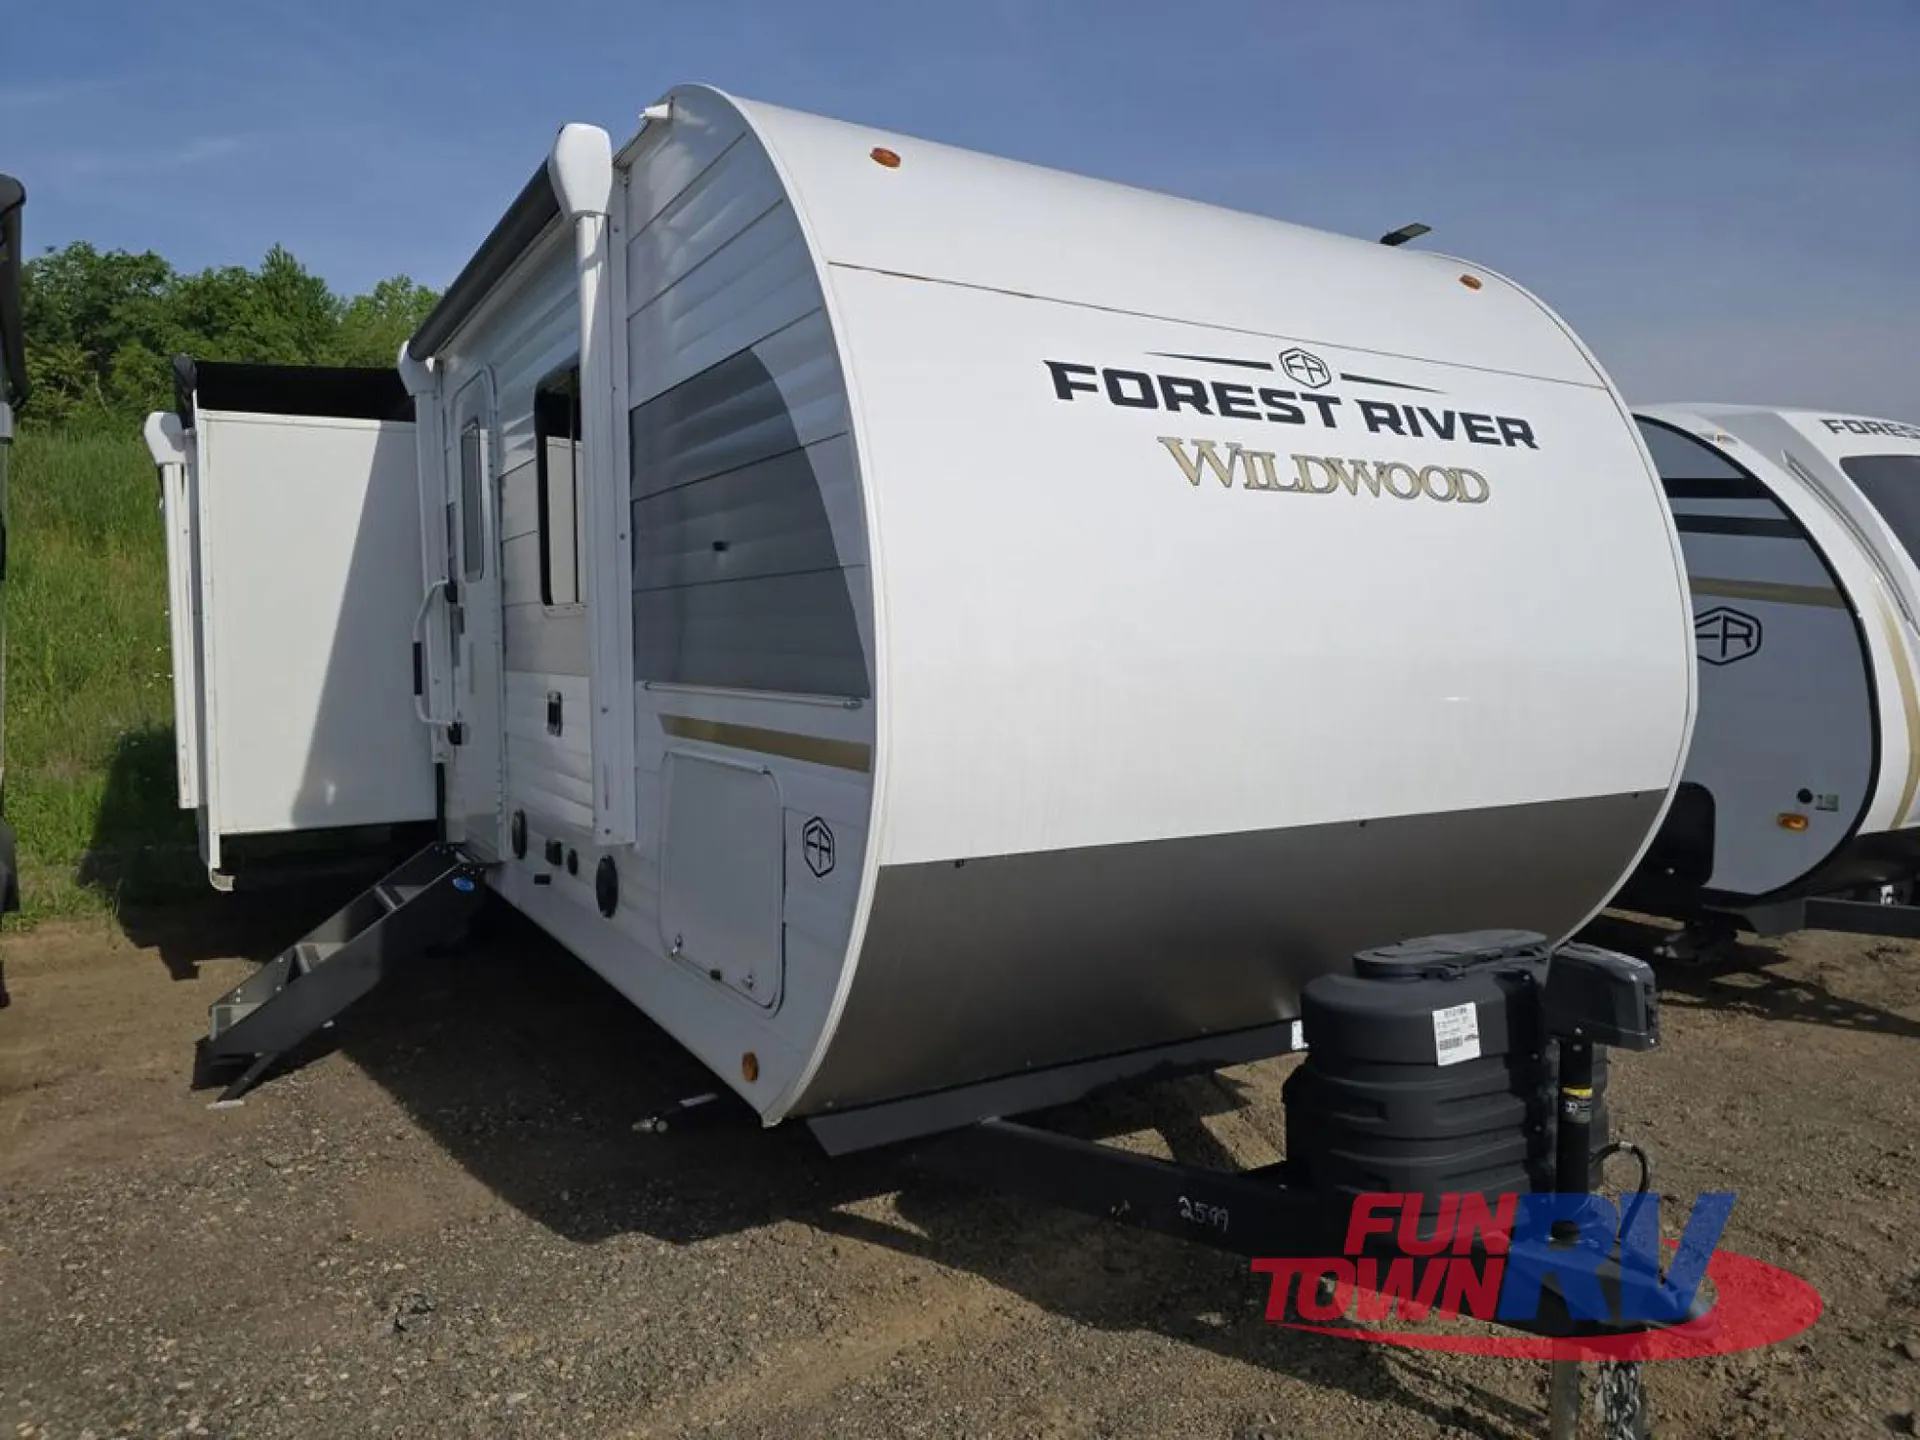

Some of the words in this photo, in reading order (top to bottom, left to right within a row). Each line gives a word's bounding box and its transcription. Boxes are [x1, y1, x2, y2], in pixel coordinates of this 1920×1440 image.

[1043, 359, 1341, 428] FOREST
[1353, 399, 1540, 450] RIVER
[1157, 436, 1490, 503] WILDWOOD
